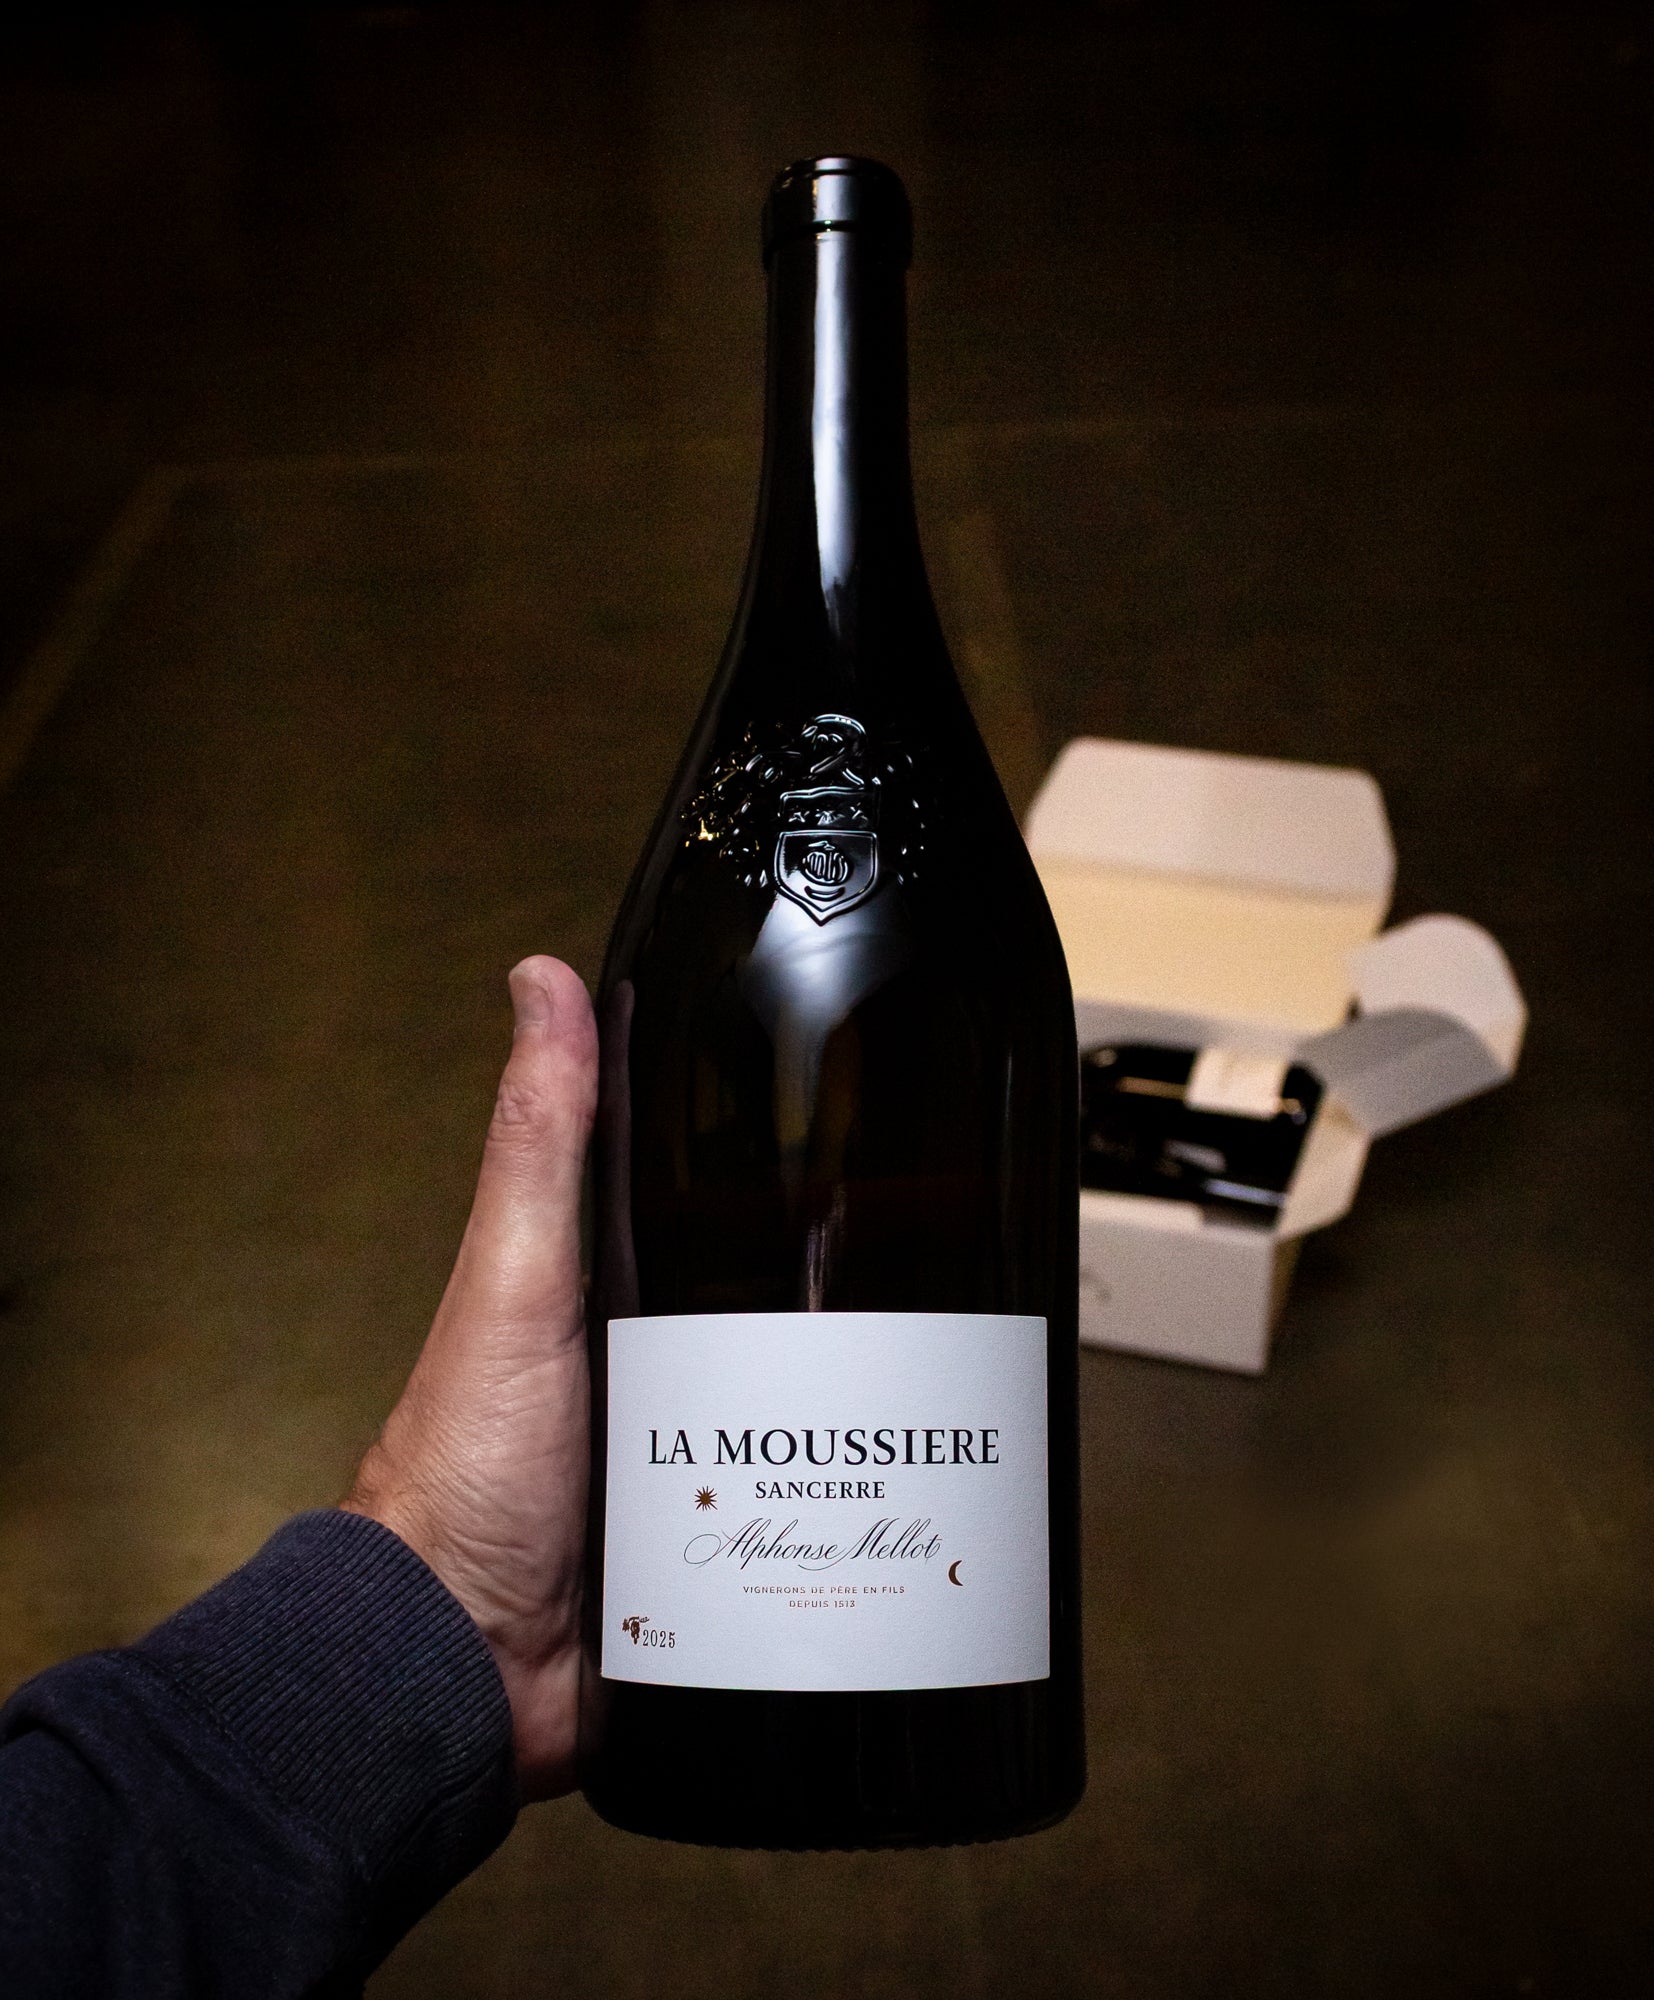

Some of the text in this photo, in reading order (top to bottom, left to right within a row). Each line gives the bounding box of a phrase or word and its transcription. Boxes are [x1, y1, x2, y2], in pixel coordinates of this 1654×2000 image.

[648, 1429, 1000, 1465] LA MOUSSIERE
[755, 1481, 885, 1499] SANCERRE
[684, 1517, 943, 1571] Alphonse Mellot
[742, 1585, 806, 1595] VIGNERONS
[810, 1585, 825, 1595] DE
[863, 1585, 878, 1595] EN
[881, 1585, 905, 1595] FILS
[789, 1600, 856, 1609] DEPUIS 1513
[642, 1629, 676, 1649] 2025
